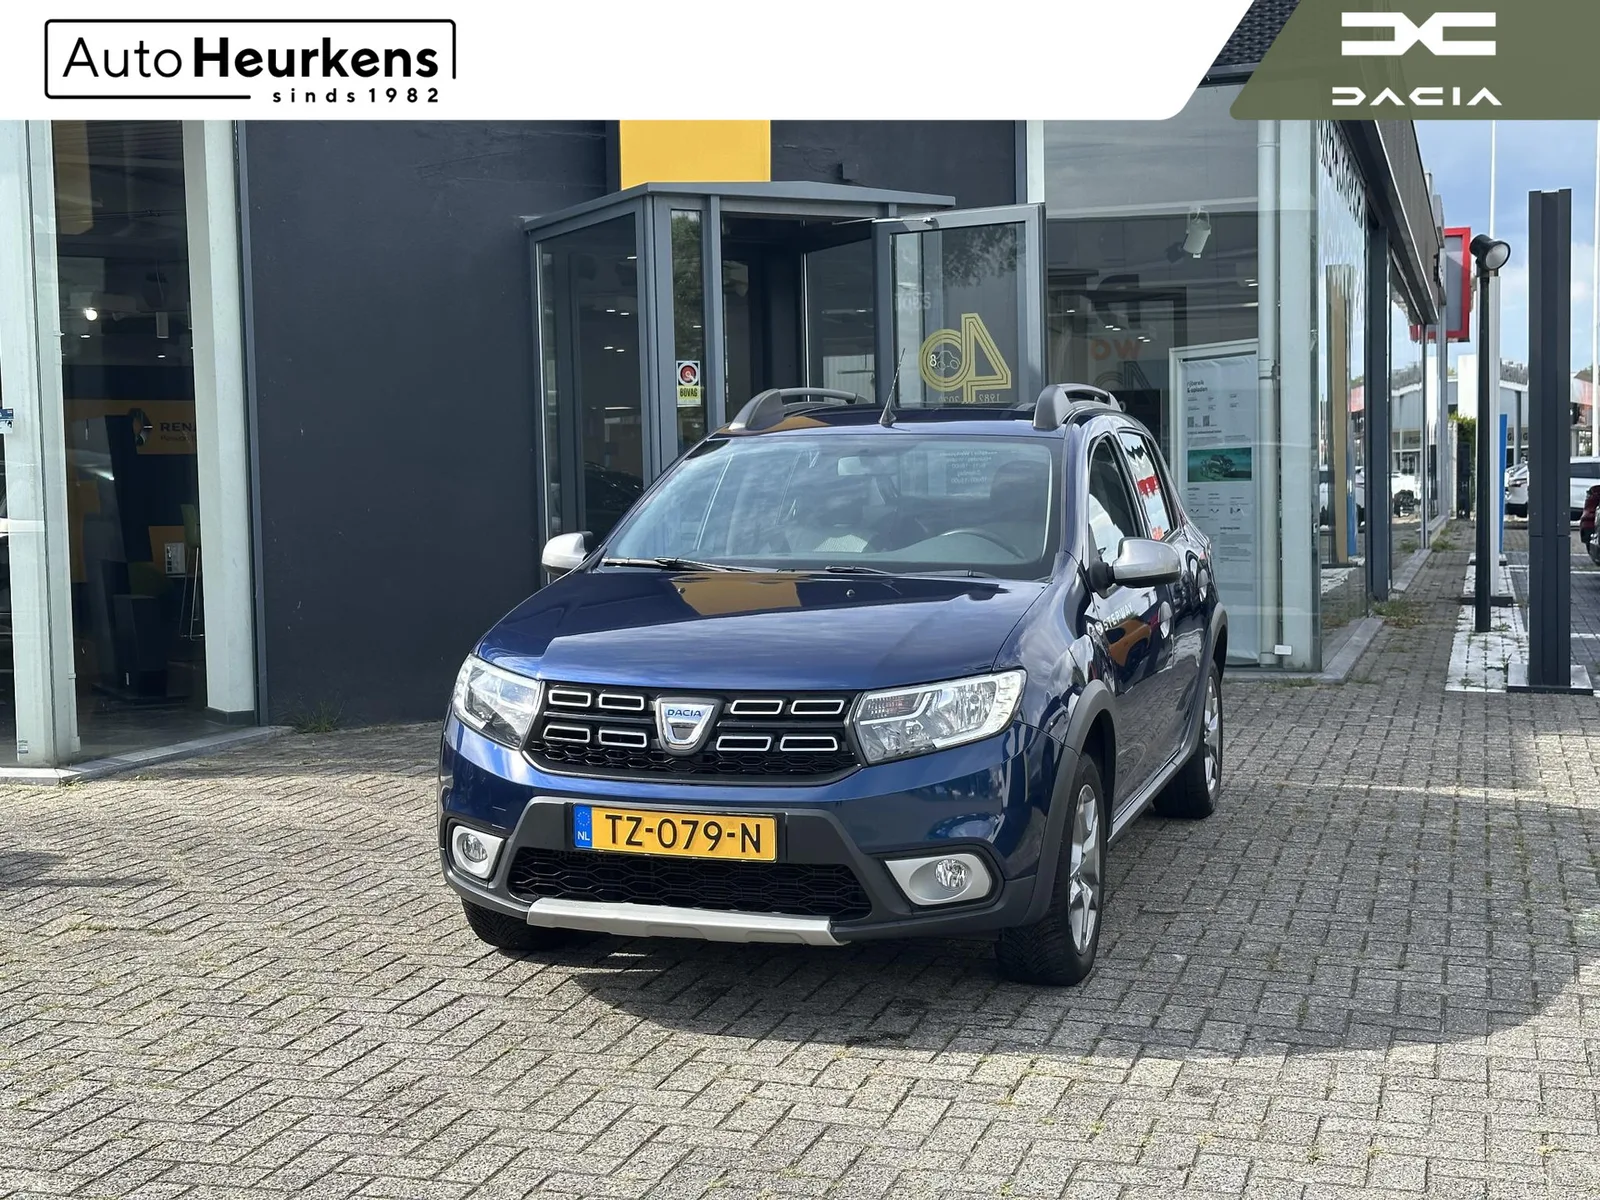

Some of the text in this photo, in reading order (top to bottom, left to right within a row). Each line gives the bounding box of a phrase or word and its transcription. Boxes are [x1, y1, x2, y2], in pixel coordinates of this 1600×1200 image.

[680, 388, 698, 397] BOVAG
[160, 422, 195, 432] REN
[1103, 602, 1133, 631] STEPWAY
[667, 708, 702, 718] DACIA
[577, 814, 761, 853] NL TZ-079-N
